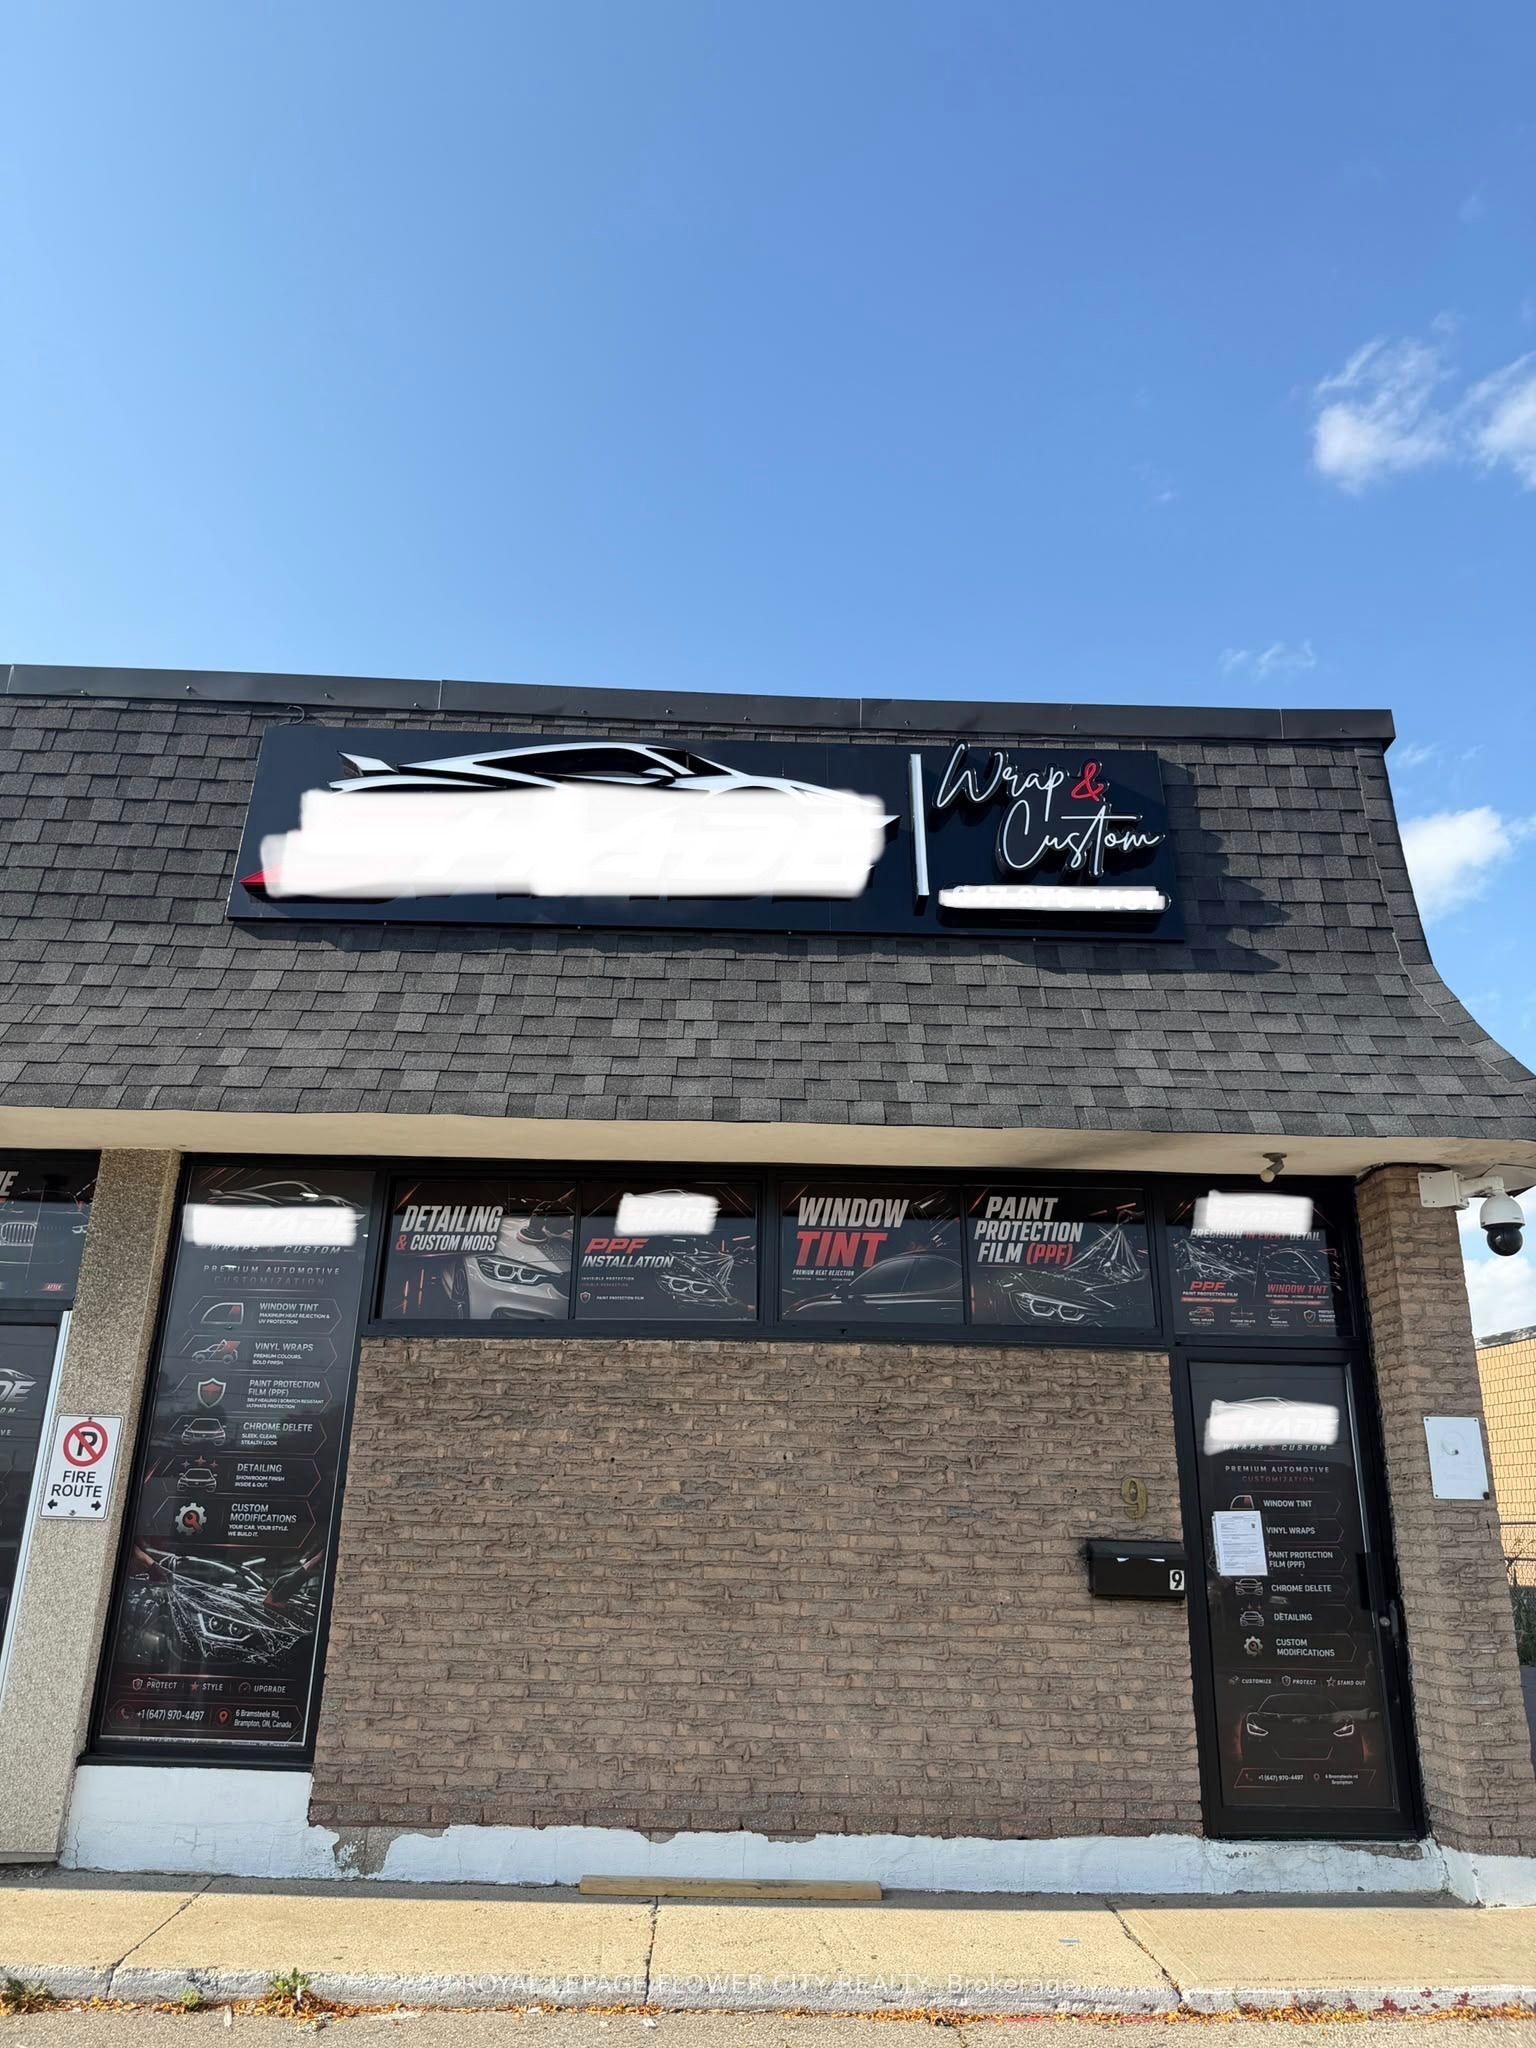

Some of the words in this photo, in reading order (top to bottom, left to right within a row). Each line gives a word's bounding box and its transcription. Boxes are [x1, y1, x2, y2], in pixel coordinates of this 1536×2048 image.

[937, 743, 1065, 823] Wrap
[1070, 761, 1105, 803] &
[1002, 799, 1161, 877] Custom
[797, 1196, 910, 1229] WINDOW
[984, 1195, 1059, 1220] PAINT
[400, 1204, 505, 1234] DETAILING
[973, 1220, 1084, 1243] PROTECTION
[1190, 1228, 1244, 1239] PRECISION
[1289, 1231, 1321, 1241] DETAIL
[395, 1234, 408, 1250] &
[409, 1234, 459, 1250] CUSTOM
[460, 1235, 498, 1252] MODS
[584, 1237, 651, 1255] PPF
[284, 1245, 343, 1255] CUSTOM
[796, 1231, 889, 1269] TINT
[977, 1243, 1021, 1264] FILM
[1025, 1243, 1074, 1266] (PPF)
[583, 1254, 676, 1269] INSTALLATION
[266, 1266, 341, 1276] AUTOMOTIVE
[792, 1268, 815, 1276] PREMIUM
[829, 1269, 855, 1277] REJECTION
[214, 1275, 326, 1287] CUSTOMIZATION
[1189, 1281, 1228, 1291] PPF
[1267, 1283, 1307, 1294] WINDOW
[1308, 1284, 1329, 1294] TINT
[259, 1302, 297, 1313] WINDOW
[299, 1303, 320, 1313] TINT
[255, 1342, 281, 1352] VINYL
[282, 1343, 315, 1353] WRAPS
[249, 1379, 272, 1388] PAINT
[272, 1380, 321, 1389] PROTECTION
[248, 1387, 267, 1397] FILM
[268, 1388, 290, 1398] (PPF)
[242, 1421, 283, 1432] CHROME
[283, 1423, 314, 1434] DELETE
[1280, 1443, 1329, 1452] CUSTOM
[237, 1463, 283, 1474] DETAILING
[1224, 1465, 1268, 1473] PREMIUM
[1270, 1465, 1330, 1474] AUTOMOTIVE
[62, 1470, 97, 1485] FIRE
[1241, 1475, 1316, 1484] CUSTOMIZATION
[51, 1483, 102, 1499] ROUTE
[1120, 1476, 1148, 1520] 9
[1263, 1499, 1295, 1508] WINDOW
[1295, 1500, 1313, 1508] TINT
[231, 1503, 270, 1513] CUSTOM
[230, 1512, 298, 1524] MODIFICATIONS
[1266, 1527, 1289, 1535] VINYL
[1289, 1527, 1316, 1535] WRAPS
[1268, 1551, 1289, 1559] PAINT
[1289, 1551, 1334, 1560] PROTECTION
[1269, 1560, 1287, 1569] FILM
[1286, 1560, 1306, 1570] (PPF)
[1171, 1570, 1183, 1589] 9
[1270, 1583, 1304, 1593] CHROME
[1303, 1584, 1333, 1593] DELETE
[1273, 1613, 1314, 1622] DETAILING
[1275, 1638, 1309, 1647] CUSTOM
[1276, 1647, 1336, 1658] MODIFICATIONS
[146, 1680, 178, 1690] PROTECT
[202, 1682, 225, 1692] STYLE
[1292, 1678, 1317, 1686] PROTECT
[254, 1684, 287, 1694] UPGRADE
[136, 1709, 146, 1719] +1
[145, 1708, 167, 1721] (647)
[167, 1709, 205, 1722] 970-4497
[271, 1720, 293, 1729] Canada
